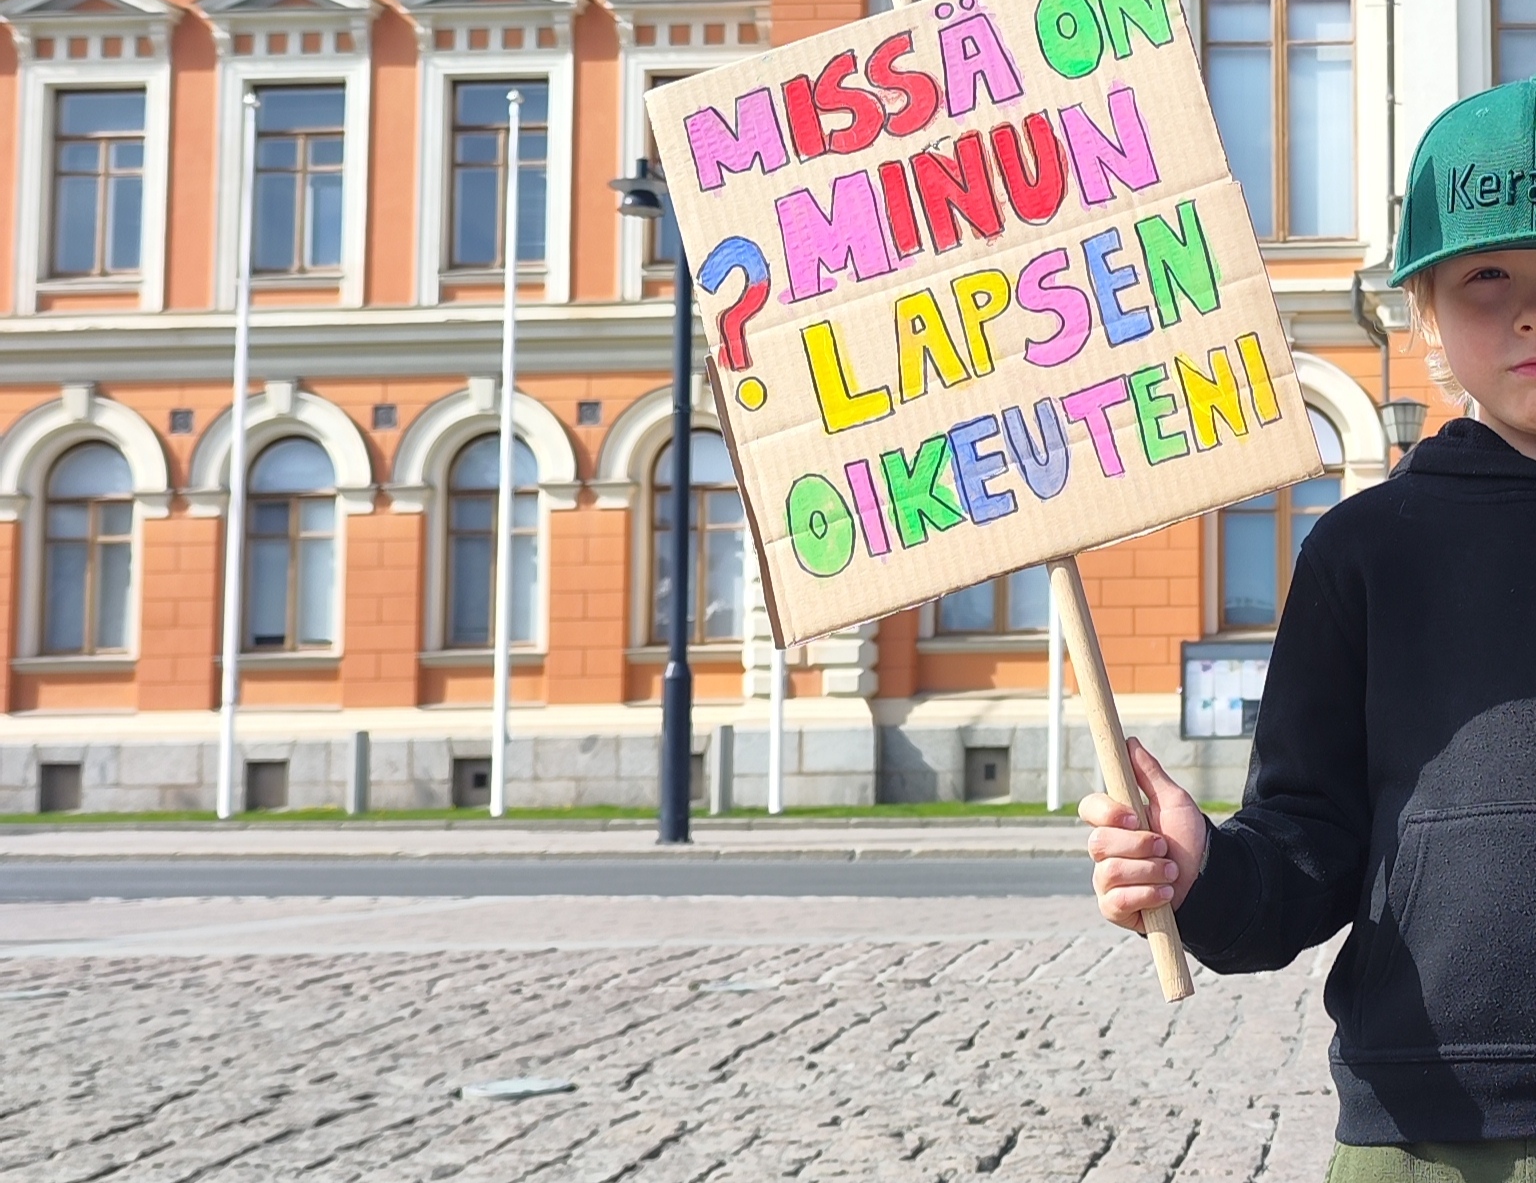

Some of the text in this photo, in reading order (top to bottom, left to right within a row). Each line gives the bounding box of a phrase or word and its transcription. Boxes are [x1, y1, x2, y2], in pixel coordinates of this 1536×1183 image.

[775, 86, 1161, 304] MINUN
[801, 199, 1220, 435] LAPSEN
[787, 331, 1281, 578] OIKEUTENI
